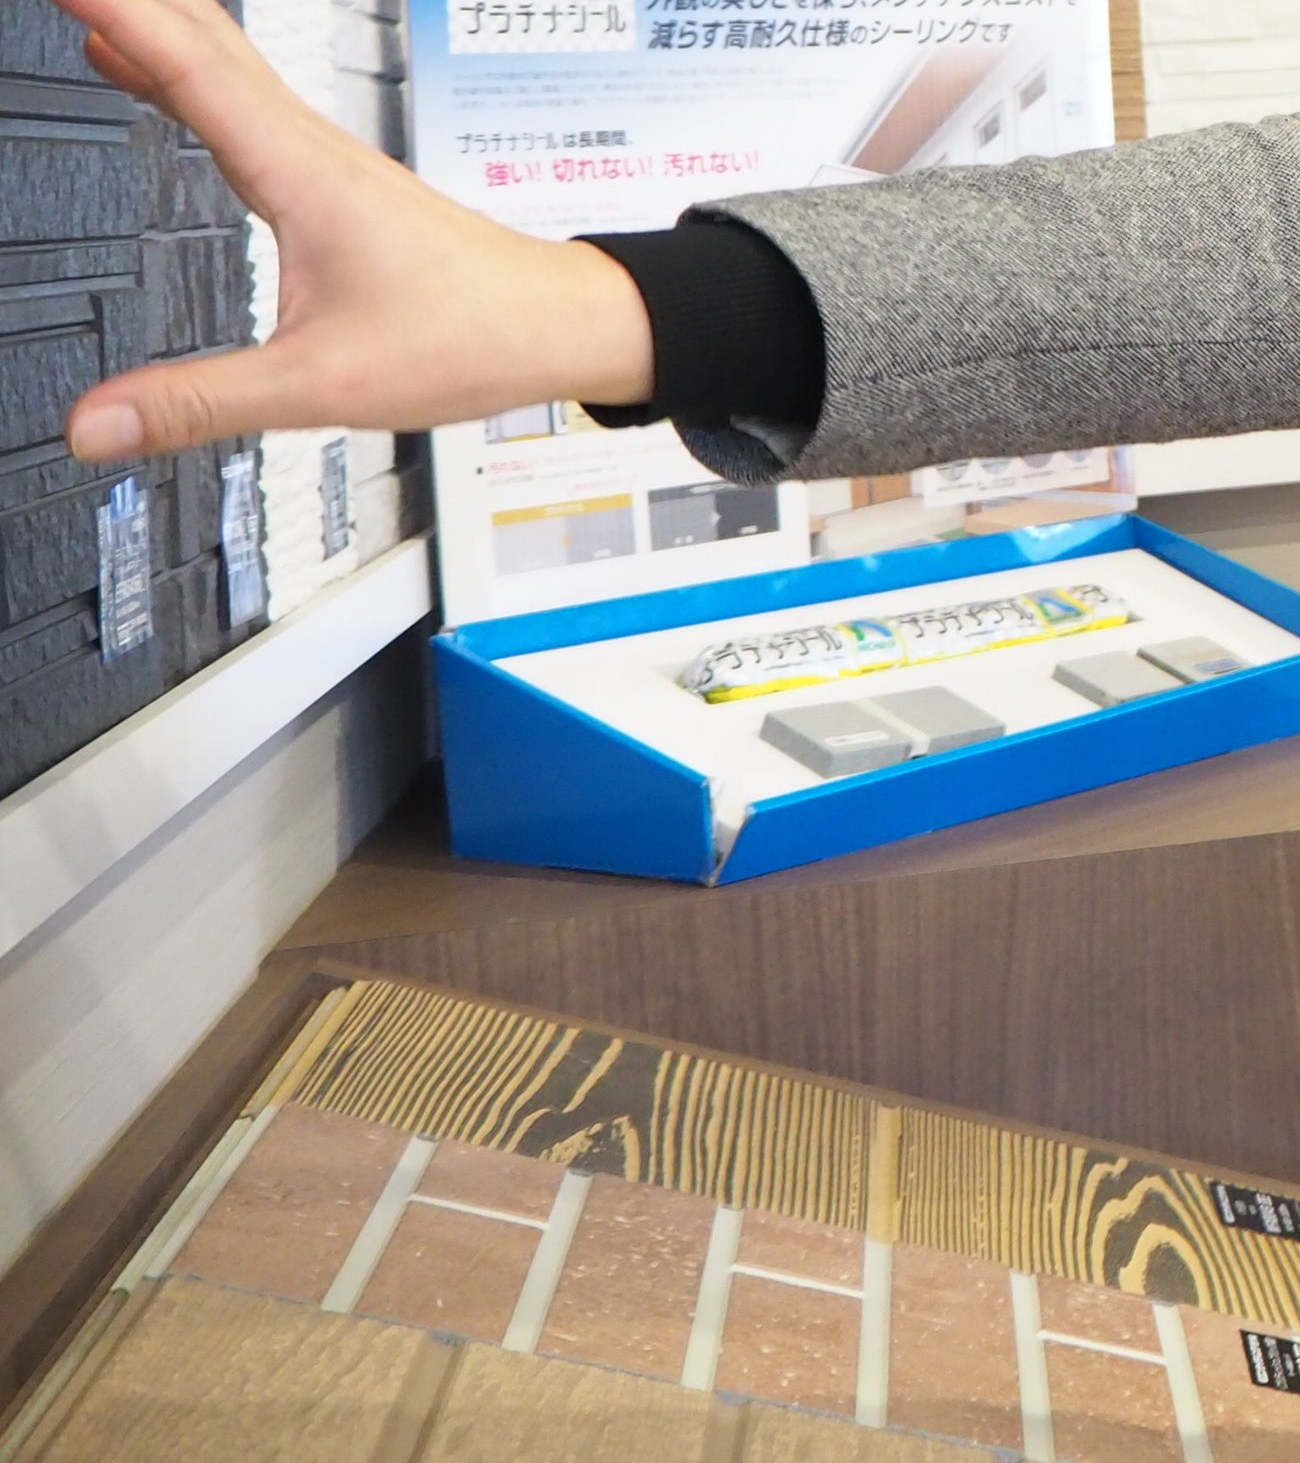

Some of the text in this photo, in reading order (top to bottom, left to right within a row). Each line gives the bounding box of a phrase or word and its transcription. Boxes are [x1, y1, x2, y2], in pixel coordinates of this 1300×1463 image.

[458, 1, 627, 35] プラチナシール
[648, 17, 1013, 50] 減らす高耐久仕様のシーリングです
